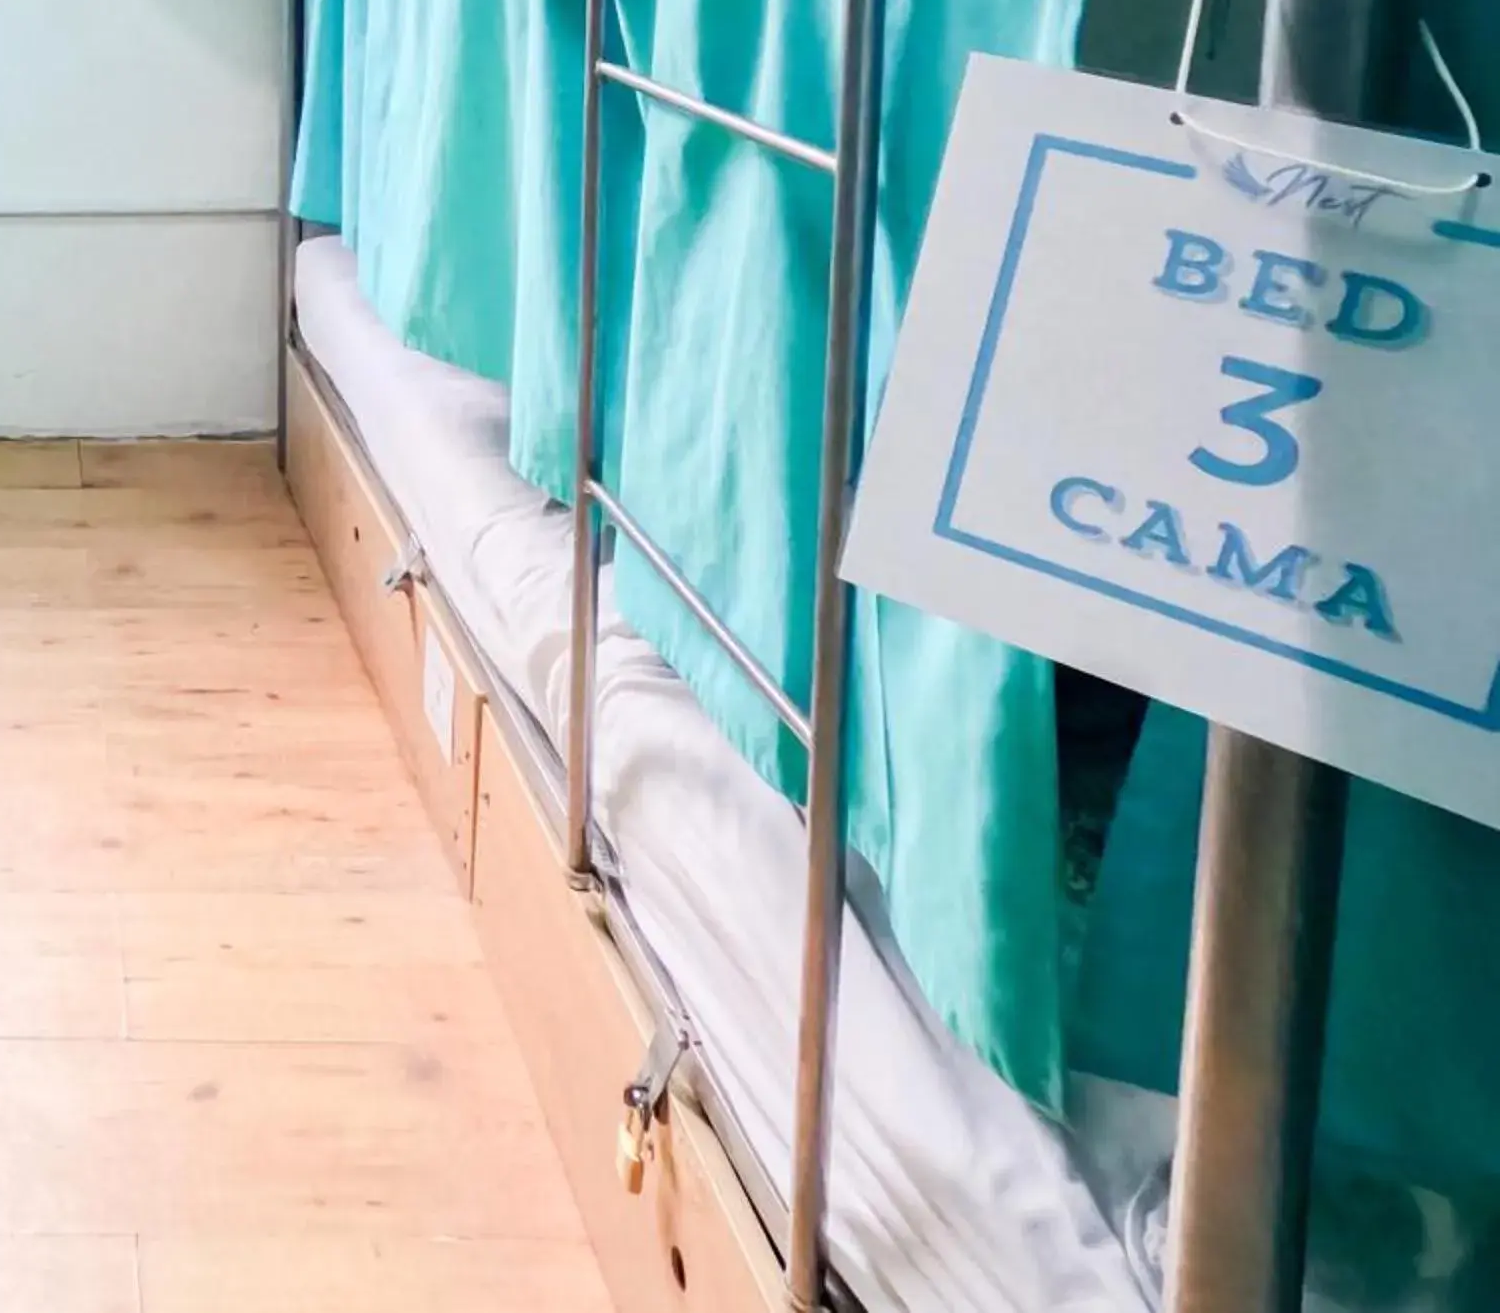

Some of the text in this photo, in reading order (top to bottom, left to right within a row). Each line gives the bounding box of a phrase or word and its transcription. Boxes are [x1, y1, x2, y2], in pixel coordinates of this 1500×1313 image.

[1153, 229, 1430, 346] BED
[1188, 355, 1323, 486] 3
[1049, 476, 1401, 641] CAMA
